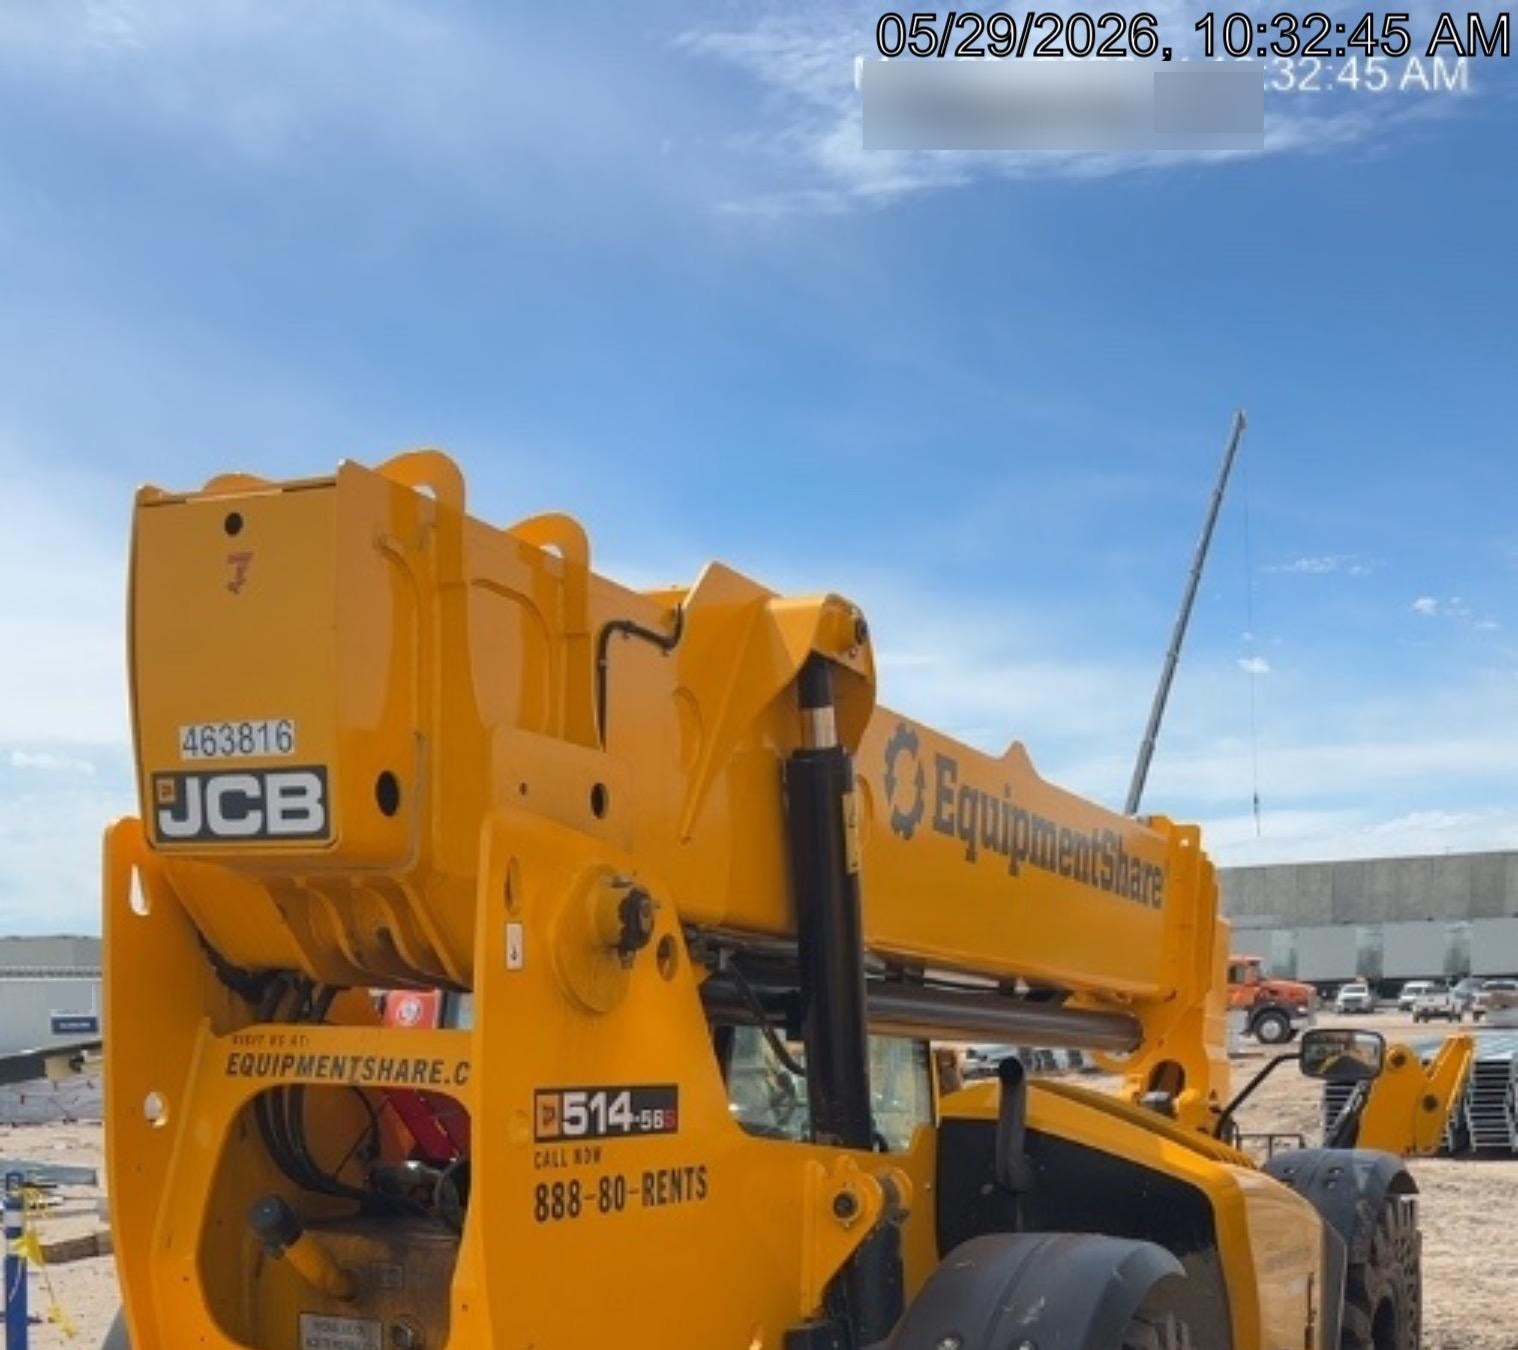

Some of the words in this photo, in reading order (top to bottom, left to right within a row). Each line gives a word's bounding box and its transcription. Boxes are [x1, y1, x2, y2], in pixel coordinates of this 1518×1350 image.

[183, 719, 293, 757] 463816
[158, 772, 325, 838] JCB
[932, 752, 1165, 909] EquipmentShare
[534, 1150, 568, 1170] CALL
[573, 1146, 602, 1165] NOW
[535, 1164, 708, 1222] 888-80-RENTS
